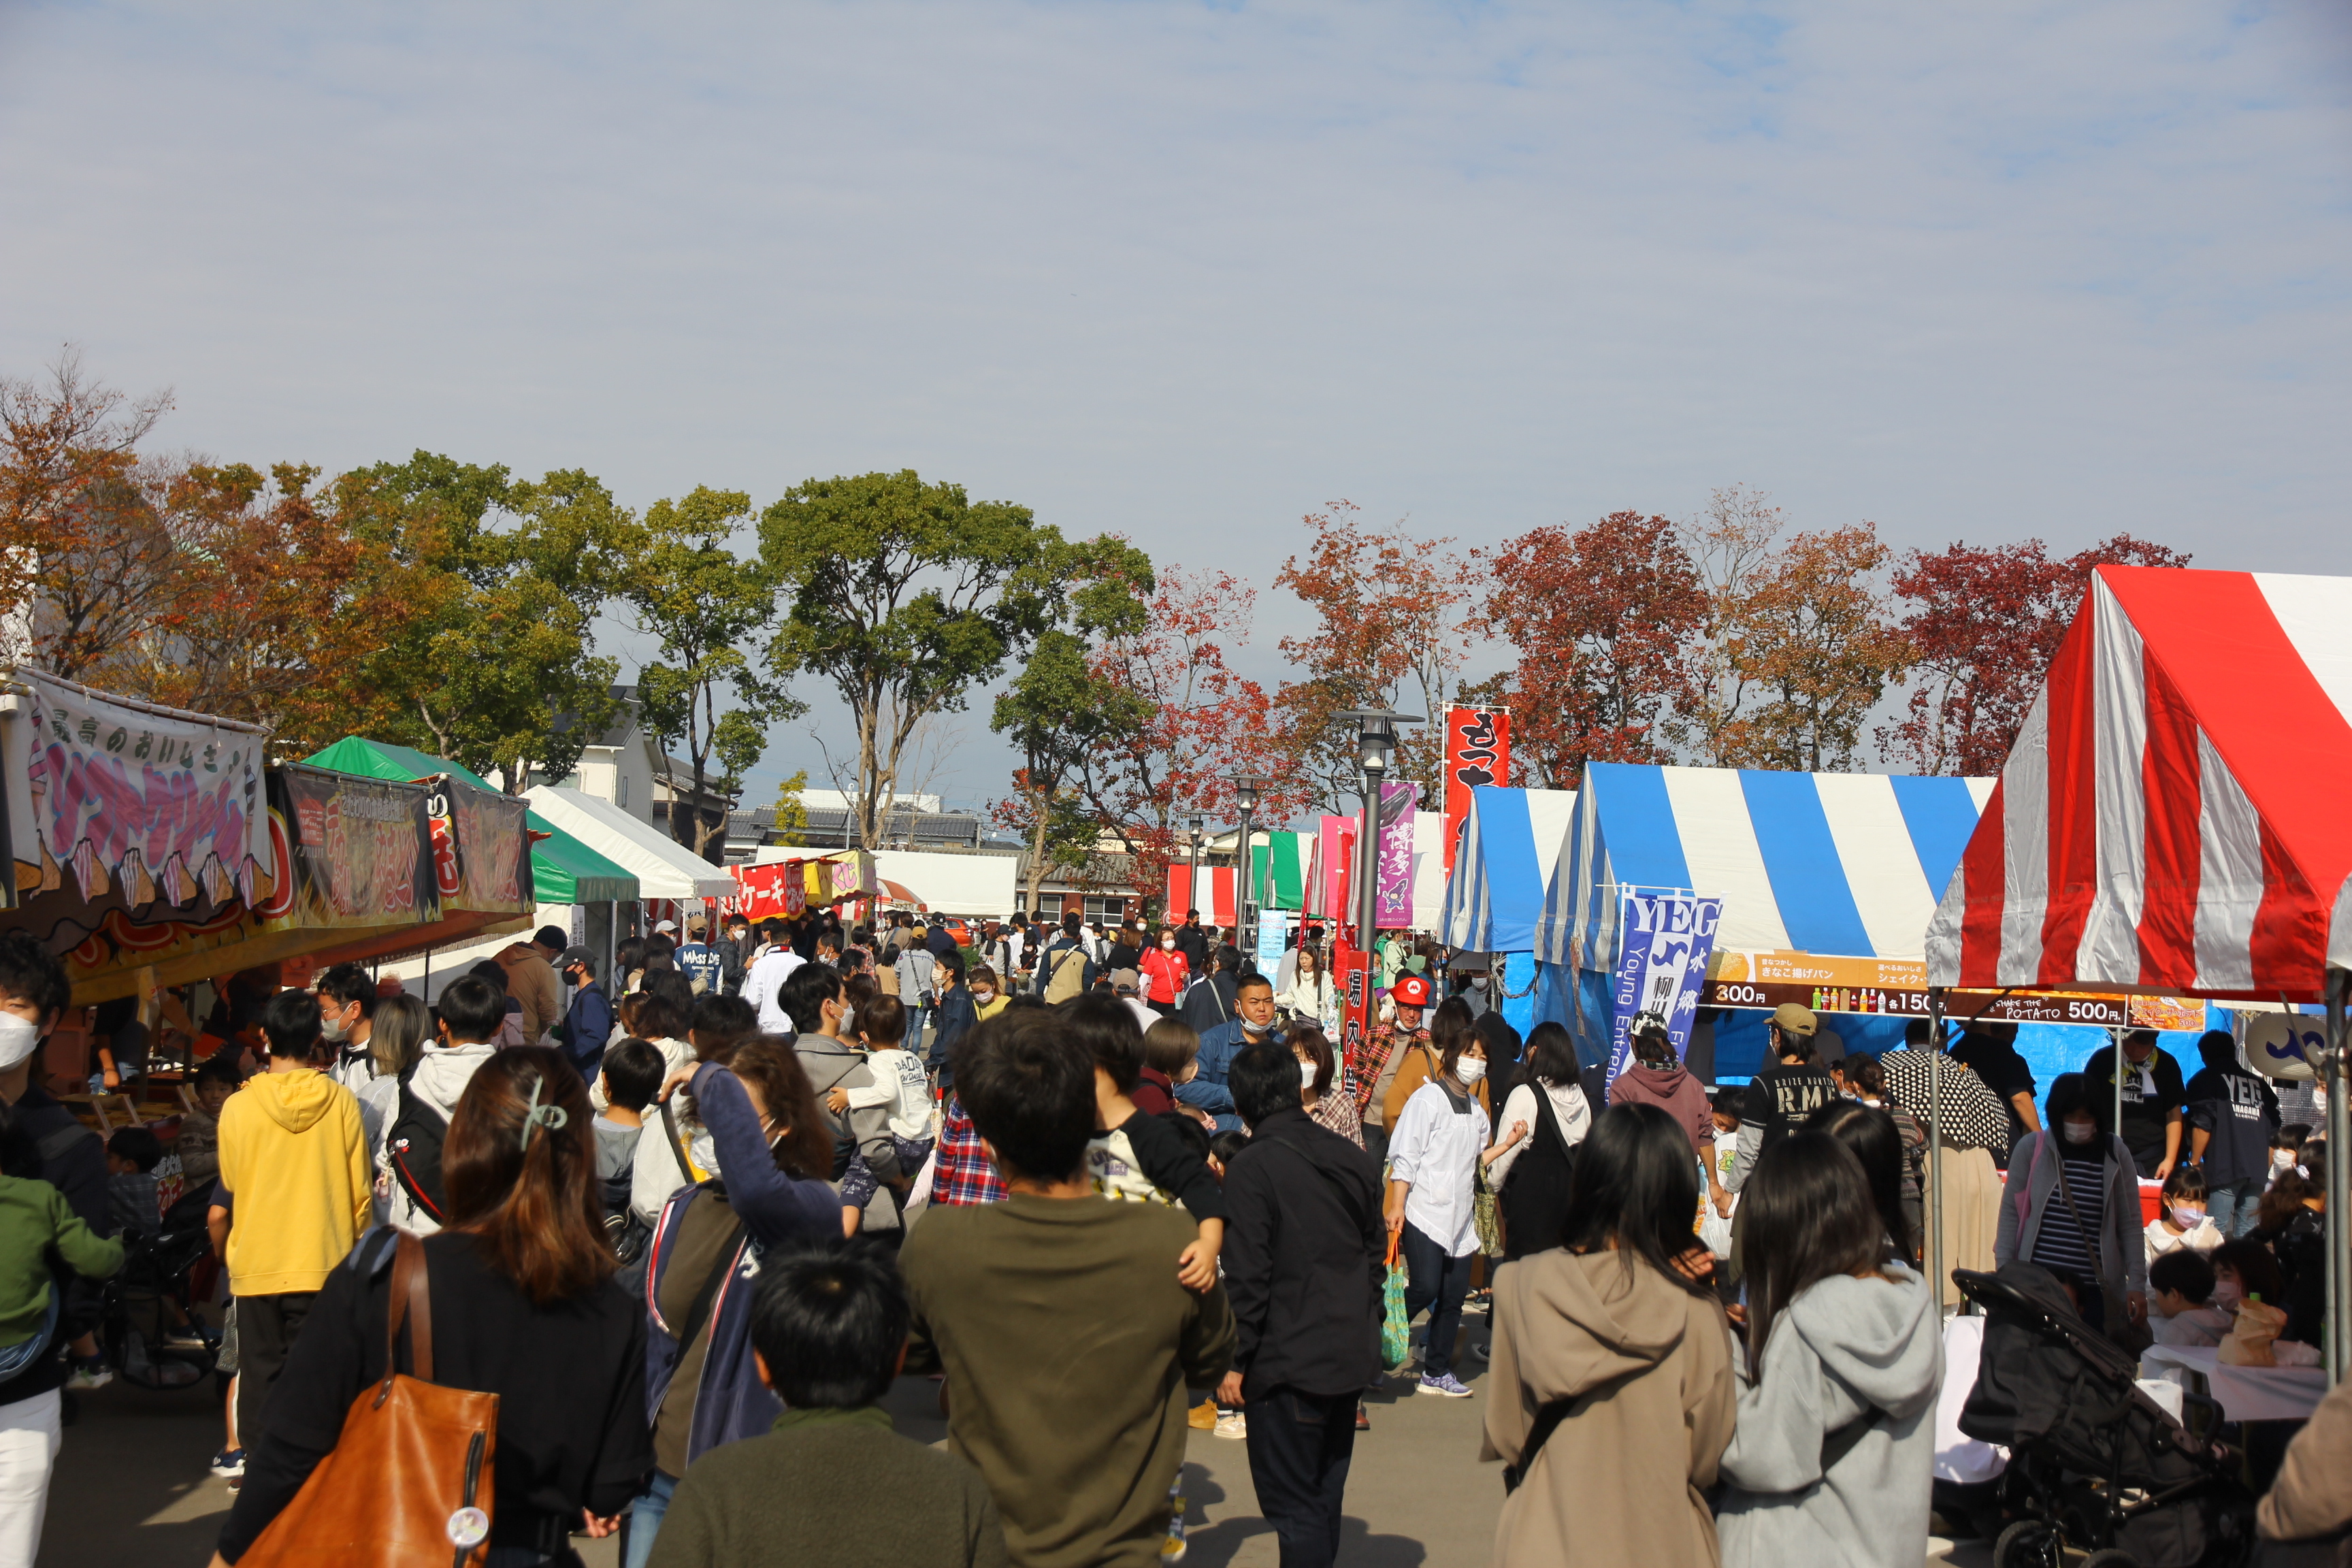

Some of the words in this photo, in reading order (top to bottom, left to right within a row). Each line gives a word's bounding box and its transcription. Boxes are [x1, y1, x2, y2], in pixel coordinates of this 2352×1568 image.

[51, 708, 218, 773] 最高のおいしさ
[46, 742, 244, 875] ソフトクリーム
[1386, 821, 1414, 876] 博多
[832, 862, 858, 892] くじ
[1633, 898, 1720, 936] YEG
[1761, 958, 1793, 966] 昔なつかし
[1761, 966, 1833, 979] きなこ揚げパン
[1878, 964, 1922, 973] 選べるおいしさ
[1617, 947, 1646, 1005] Young
[1674, 947, 1707, 1016] 水郷
[1878, 973, 1927, 984] シェイク・
[2006, 1008, 2061, 1019] POTATO
[2023, 999, 2041, 1007] THE
[909, 1072, 925, 1081] DADD
[1774, 1077, 1802, 1088] BRIZE
[2221, 1073, 2261, 1105] YEG
